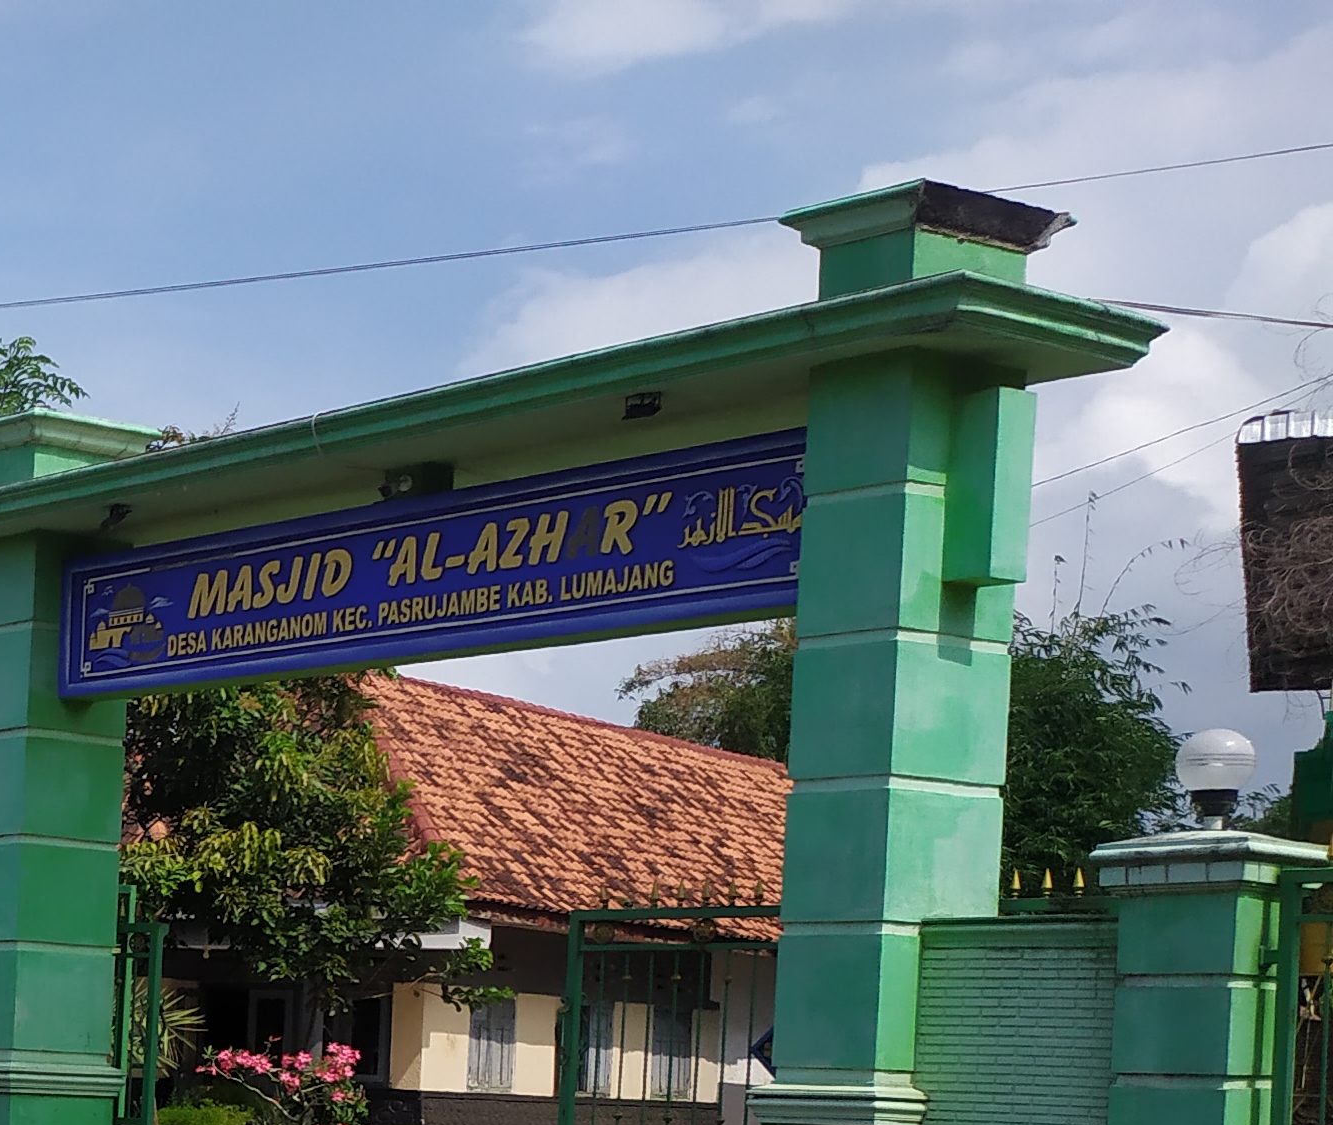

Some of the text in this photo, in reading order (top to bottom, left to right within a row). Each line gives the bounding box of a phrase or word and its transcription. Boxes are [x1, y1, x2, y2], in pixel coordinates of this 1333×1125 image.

[167, 559, 674, 657] DESA KARANGANOM KEC. PASRUJAMBE KAB. LUMAJANG
[187, 549, 352, 619] MASJID
